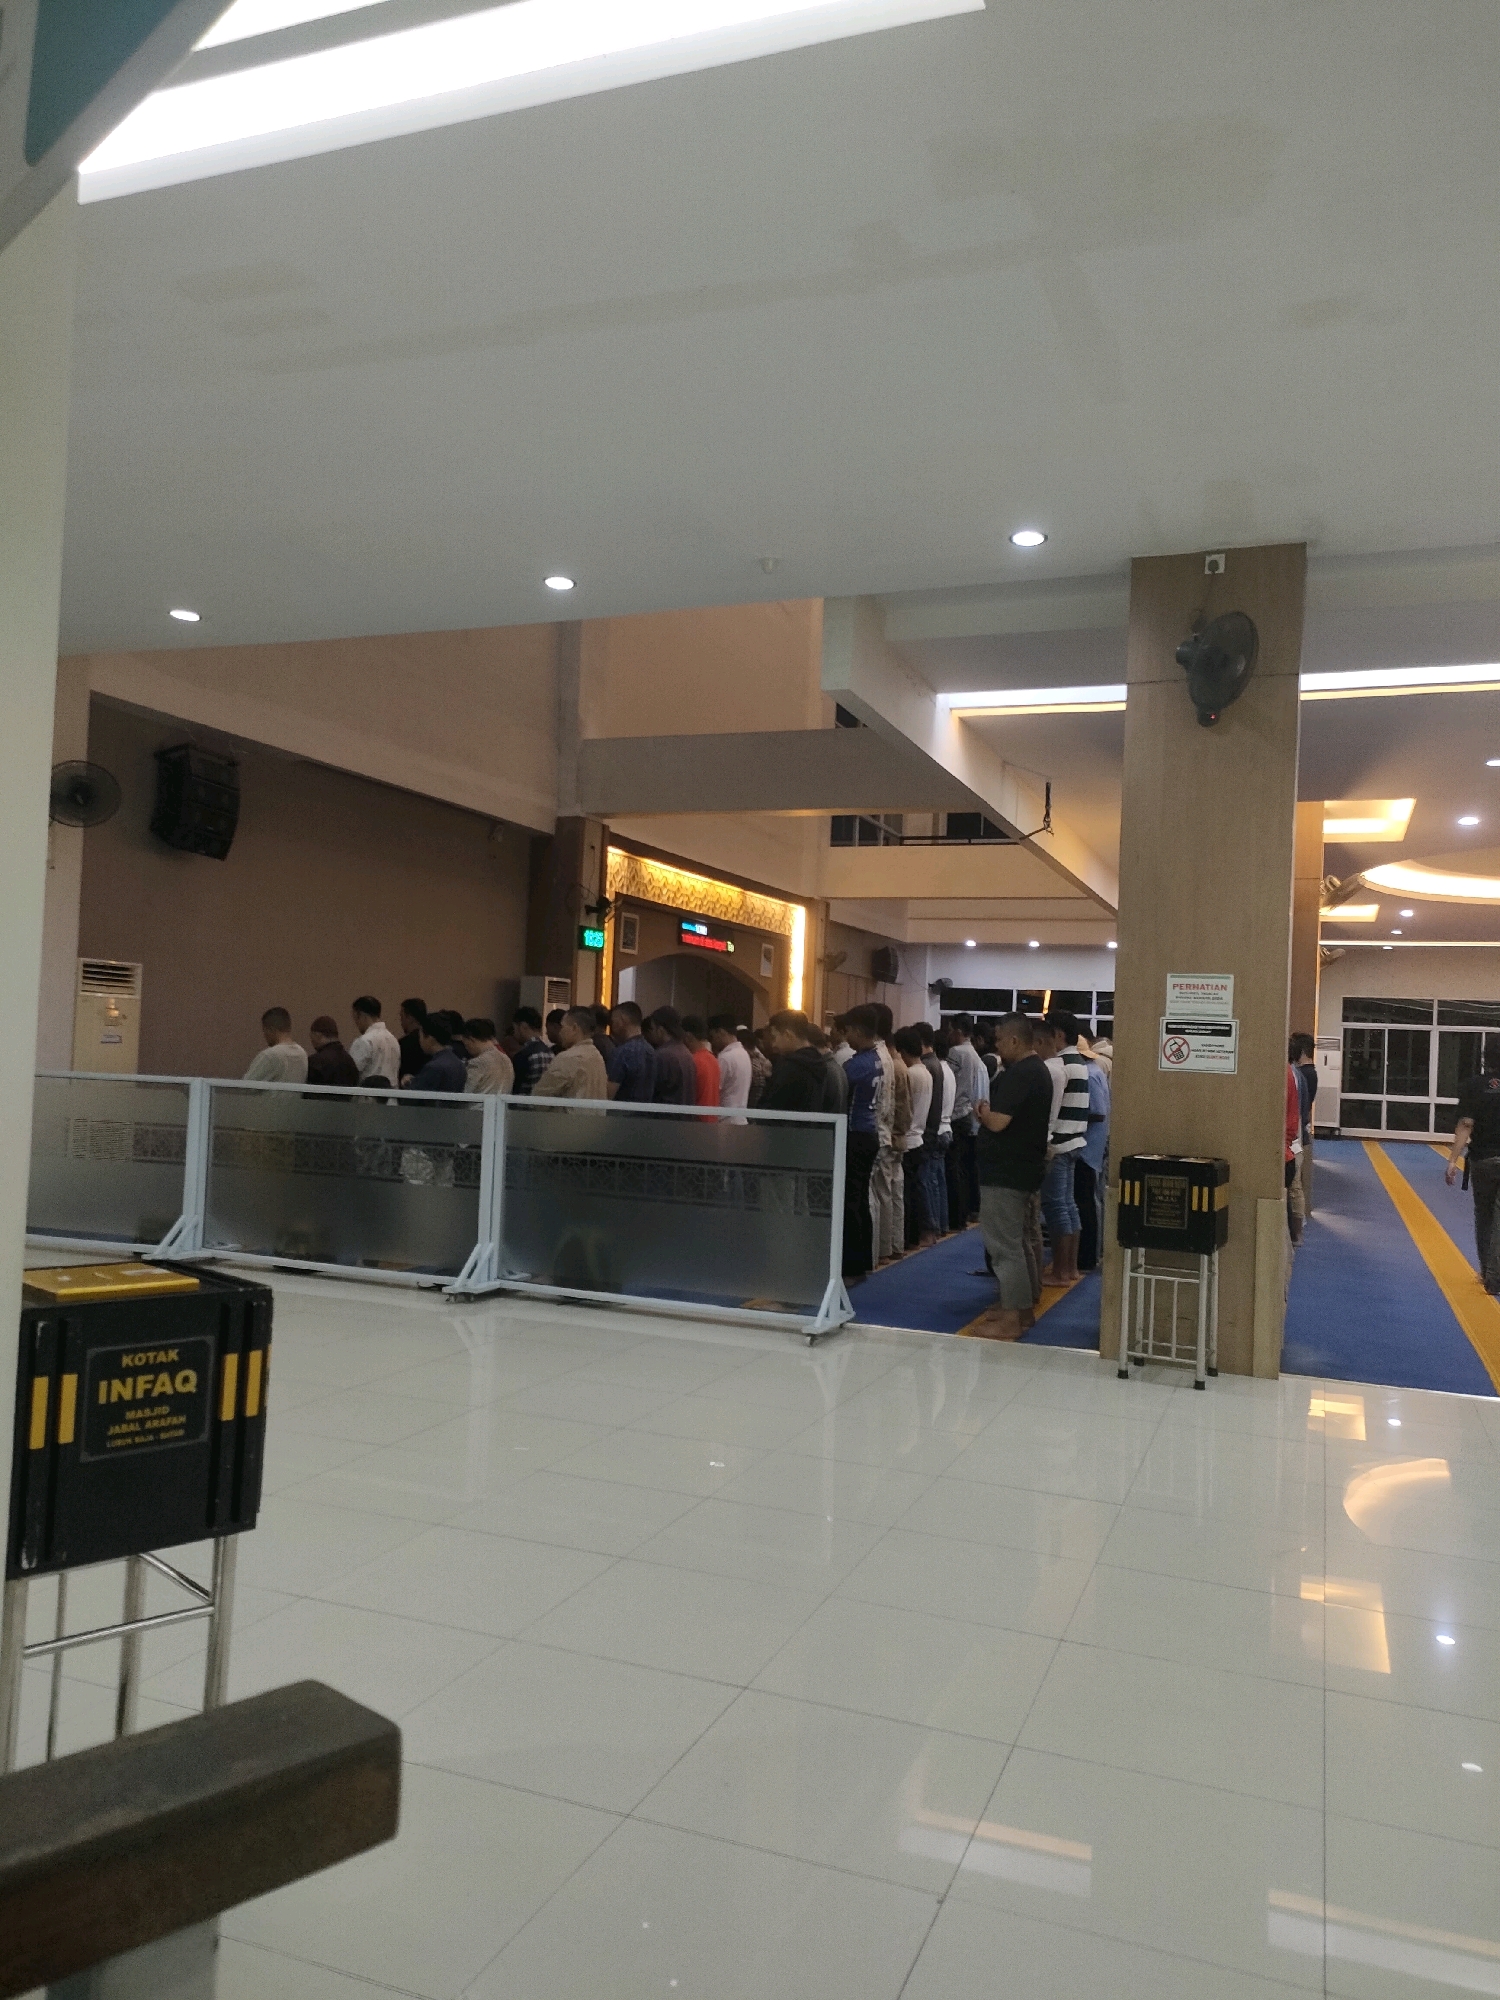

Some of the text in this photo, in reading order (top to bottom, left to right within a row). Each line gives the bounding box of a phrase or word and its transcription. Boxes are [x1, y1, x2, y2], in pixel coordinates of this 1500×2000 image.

[1172, 983, 1228, 991] PERHATIAN
[122, 1349, 179, 1368] KOTAK
[98, 1369, 198, 1404] INFAQ
[125, 1406, 170, 1420] MASJID
[107, 1415, 187, 1436] JABAL ARAFAH
